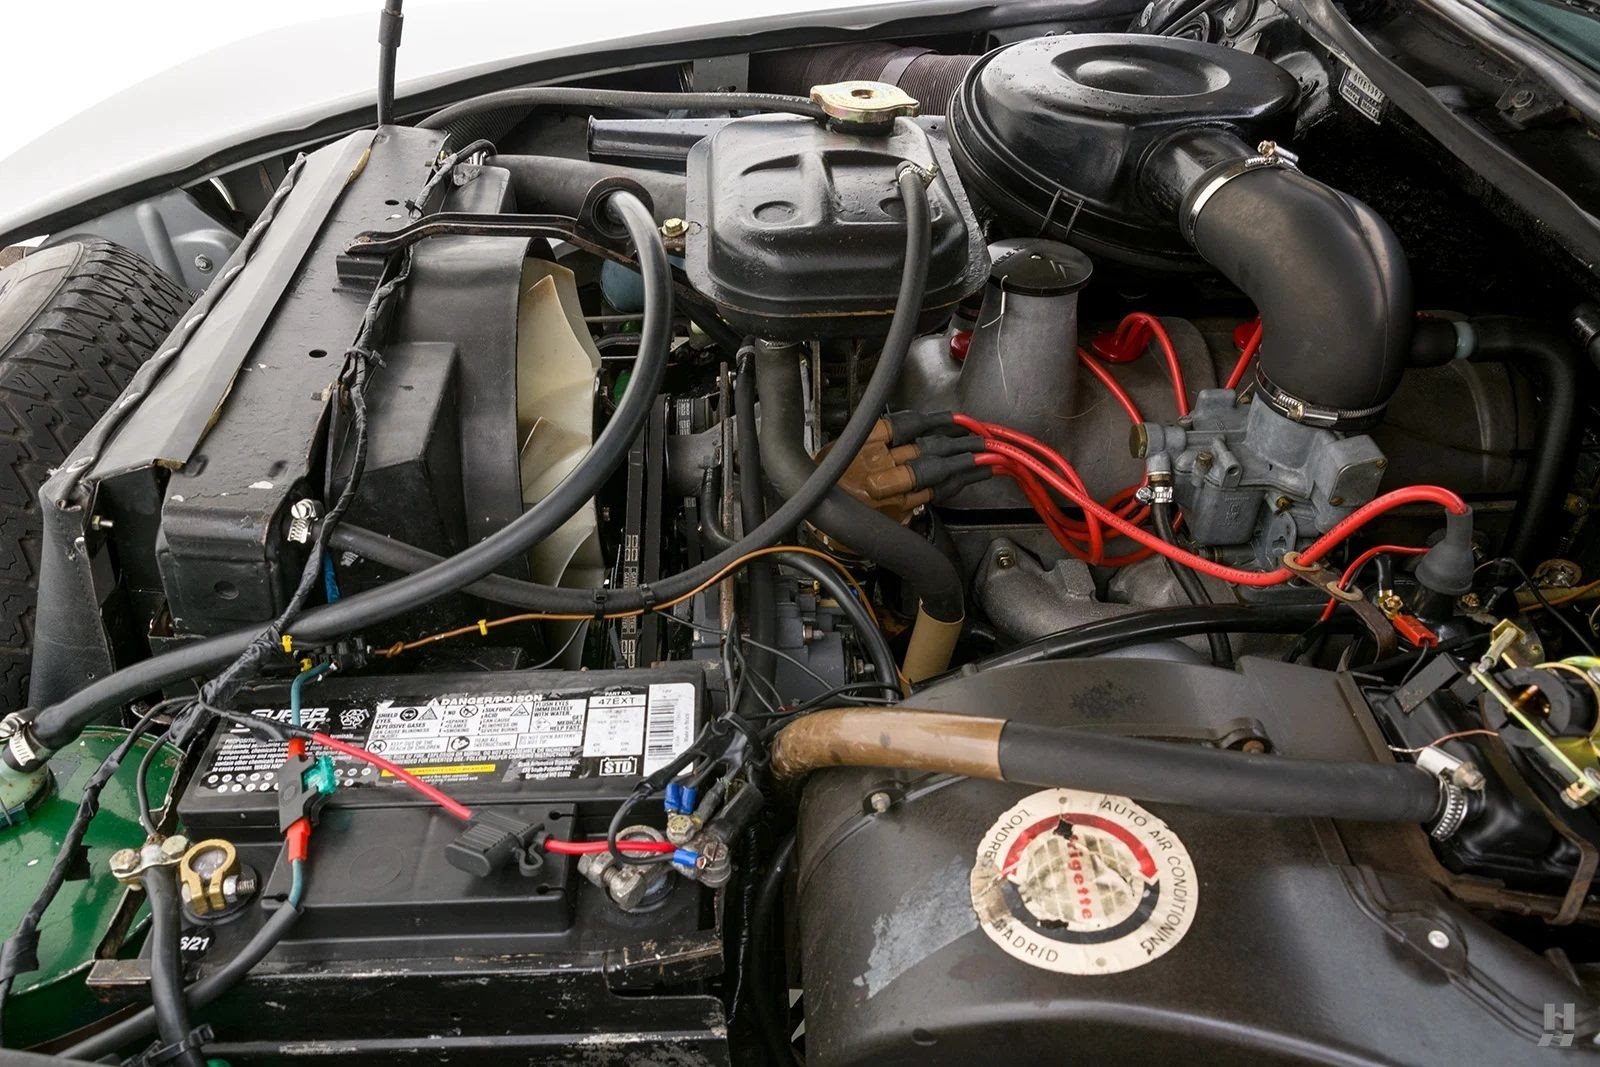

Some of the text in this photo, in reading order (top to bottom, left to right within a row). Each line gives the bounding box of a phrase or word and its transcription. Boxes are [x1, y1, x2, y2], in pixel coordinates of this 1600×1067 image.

[441, 695, 543, 706] DANGER/POISON
[598, 697, 636, 706] 47EXT
[604, 760, 632, 774] STD
[983, 808, 1032, 866] LONDRES
[1101, 799, 1189, 957] AUTO AIR CONDITIONING
[992, 918, 1060, 963] MADRID
